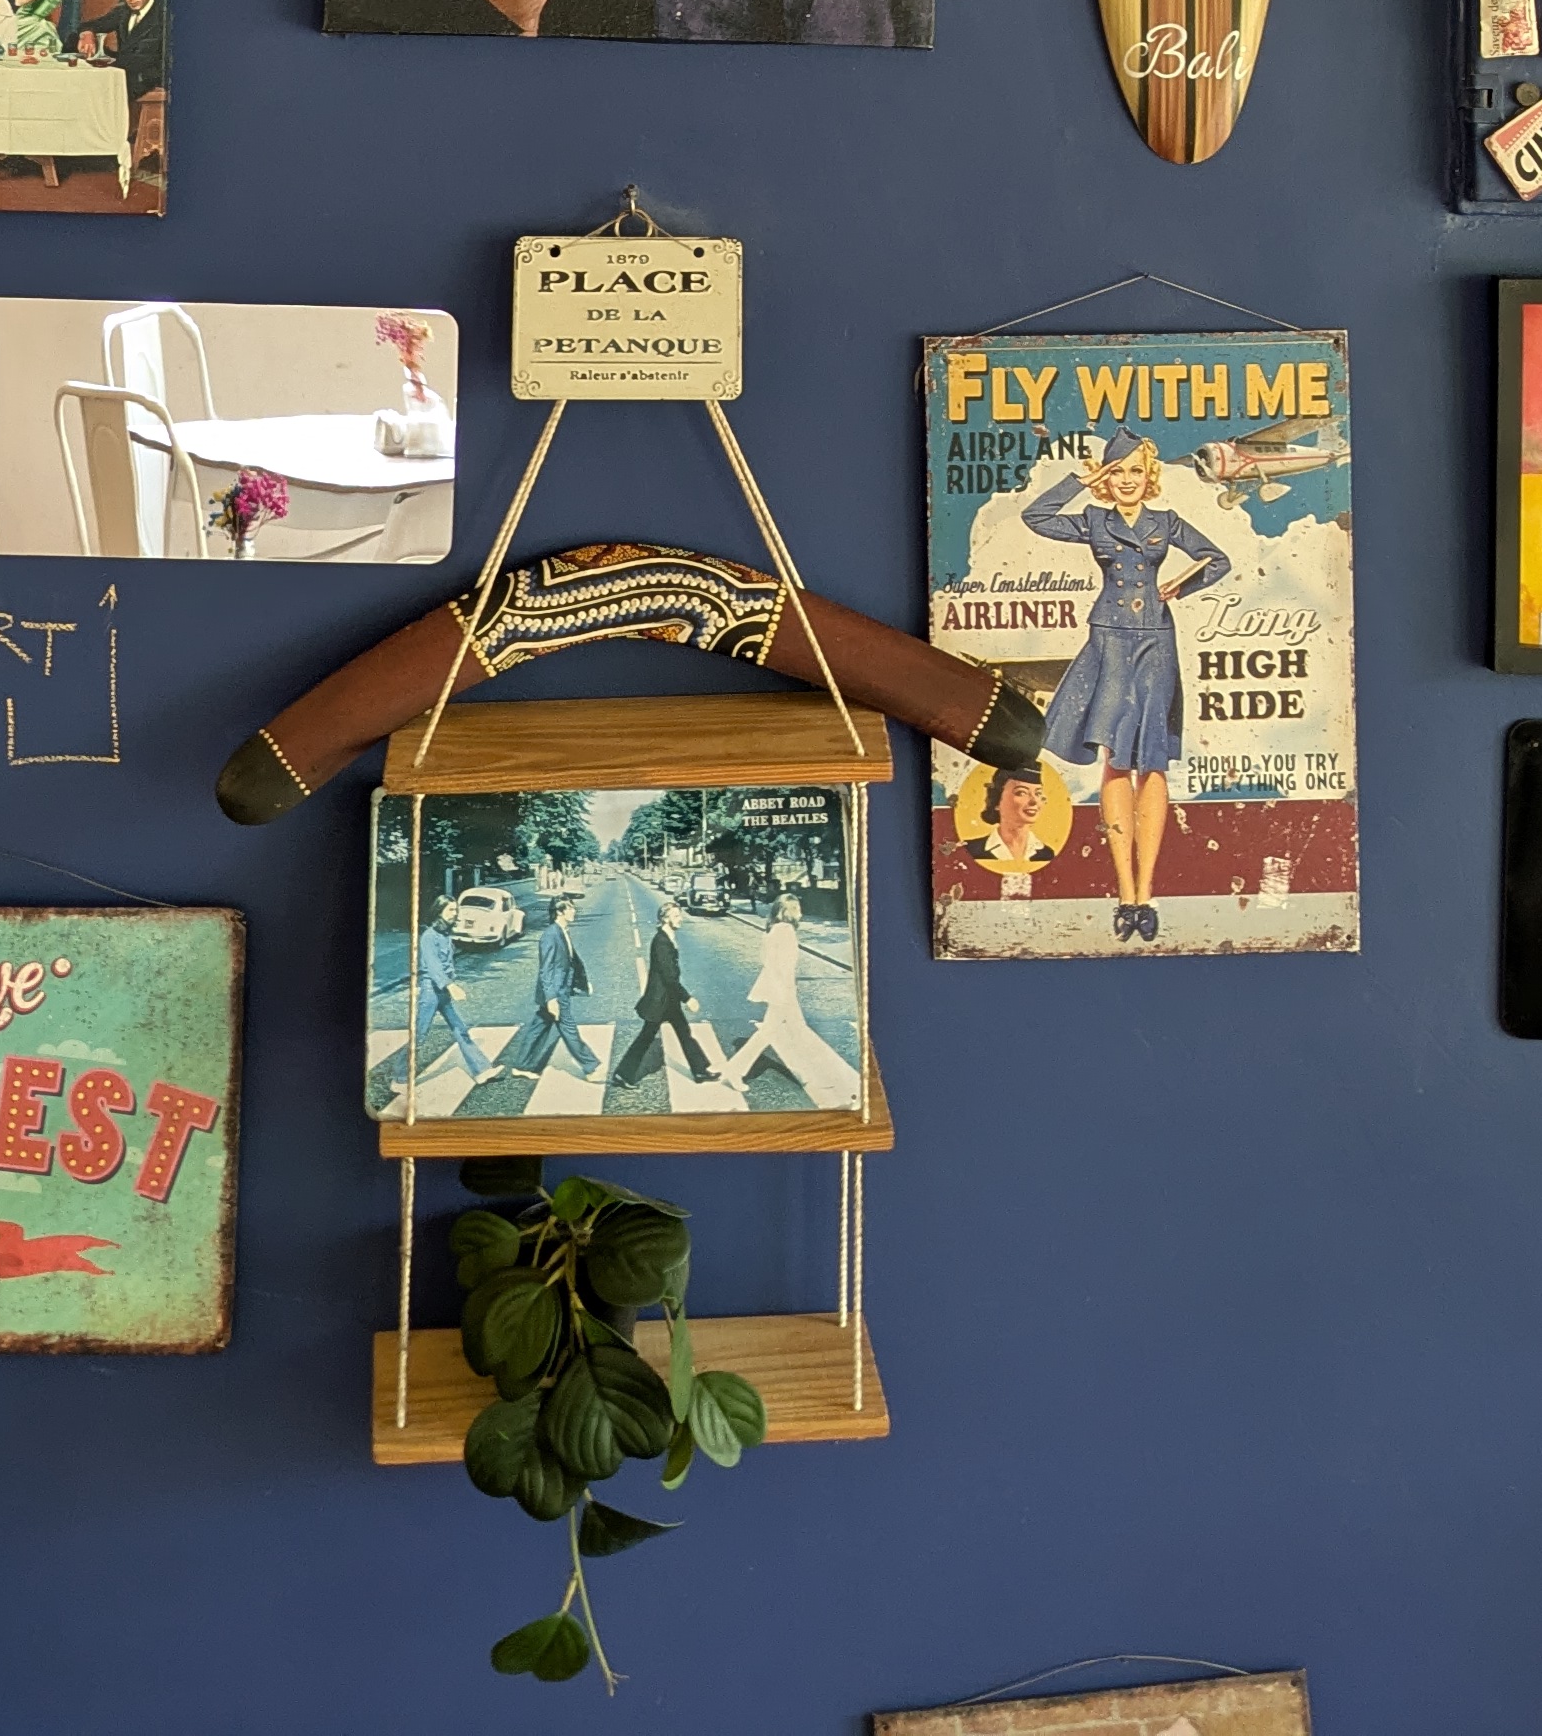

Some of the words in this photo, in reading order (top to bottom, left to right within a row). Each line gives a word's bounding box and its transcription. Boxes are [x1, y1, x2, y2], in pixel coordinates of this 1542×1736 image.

[1122, 22, 1252, 82] Bali
[537, 270, 712, 294] PLACE
[587, 309, 621, 321] DE
[633, 309, 667, 321] LA
[533, 338, 723, 357] PETANQUE
[569, 369, 617, 381] Raleur
[619, 369, 690, 381] s'abstenir
[945, 352, 1059, 423] FLY
[1076, 364, 1230, 422] WITH
[1245, 362, 1331, 418] ME
[947, 430, 1094, 462] AIRPLANE
[946, 464, 1031, 495] RIDES
[942, 572, 988, 599] Super
[989, 570, 1097, 594] Constellations
[941, 599, 1078, 631] AIRLINER
[1195, 593, 1321, 646] Long
[1197, 649, 1309, 681] HIGH
[1198, 689, 1305, 722] RIDE
[1187, 755, 1252, 774] SHOULD
[1261, 754, 1296, 772] YOU
[1304, 752, 1339, 771] TRY
[1305, 771, 1347, 790] ONCE
[741, 795, 785, 811] ABBEY
[789, 795, 826, 810] ROAD
[742, 813, 769, 827] THE
[771, 811, 829, 826] BEATLES
